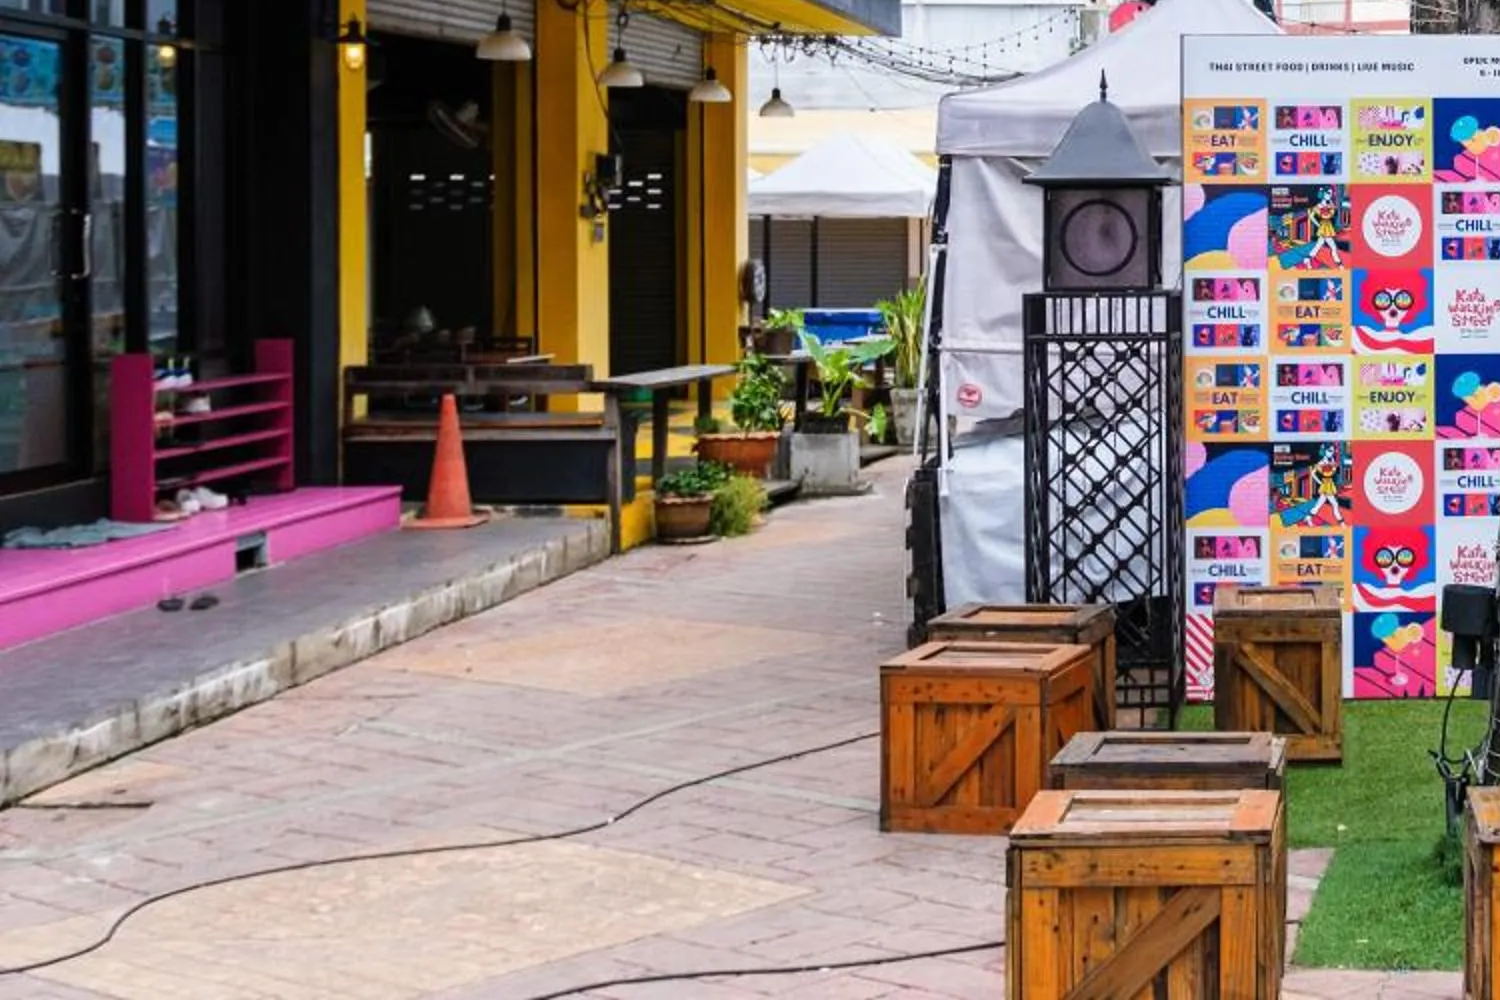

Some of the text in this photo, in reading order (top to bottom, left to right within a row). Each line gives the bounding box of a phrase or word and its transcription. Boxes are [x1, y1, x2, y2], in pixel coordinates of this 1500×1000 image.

[1209, 62, 1414, 72] THAI STREET FOOD DRINKS LIVE MUSIC
[1211, 134, 1236, 147] EAT
[1289, 134, 1328, 147] CHILL
[1368, 134, 1413, 147] ENJOY
[1455, 219, 1493, 232] CHILL
[1206, 306, 1246, 319] CHILL
[1295, 306, 1320, 319] EAT
[1212, 392, 1238, 404] EAT
[1290, 392, 1329, 404] CHILL
[1369, 391, 1415, 404] ENJOY
[1457, 477, 1495, 489] CHILL
[1207, 564, 1247, 577] CHILL
[1296, 564, 1322, 576] EAT
[1449, 559, 1495, 574] Walkin
